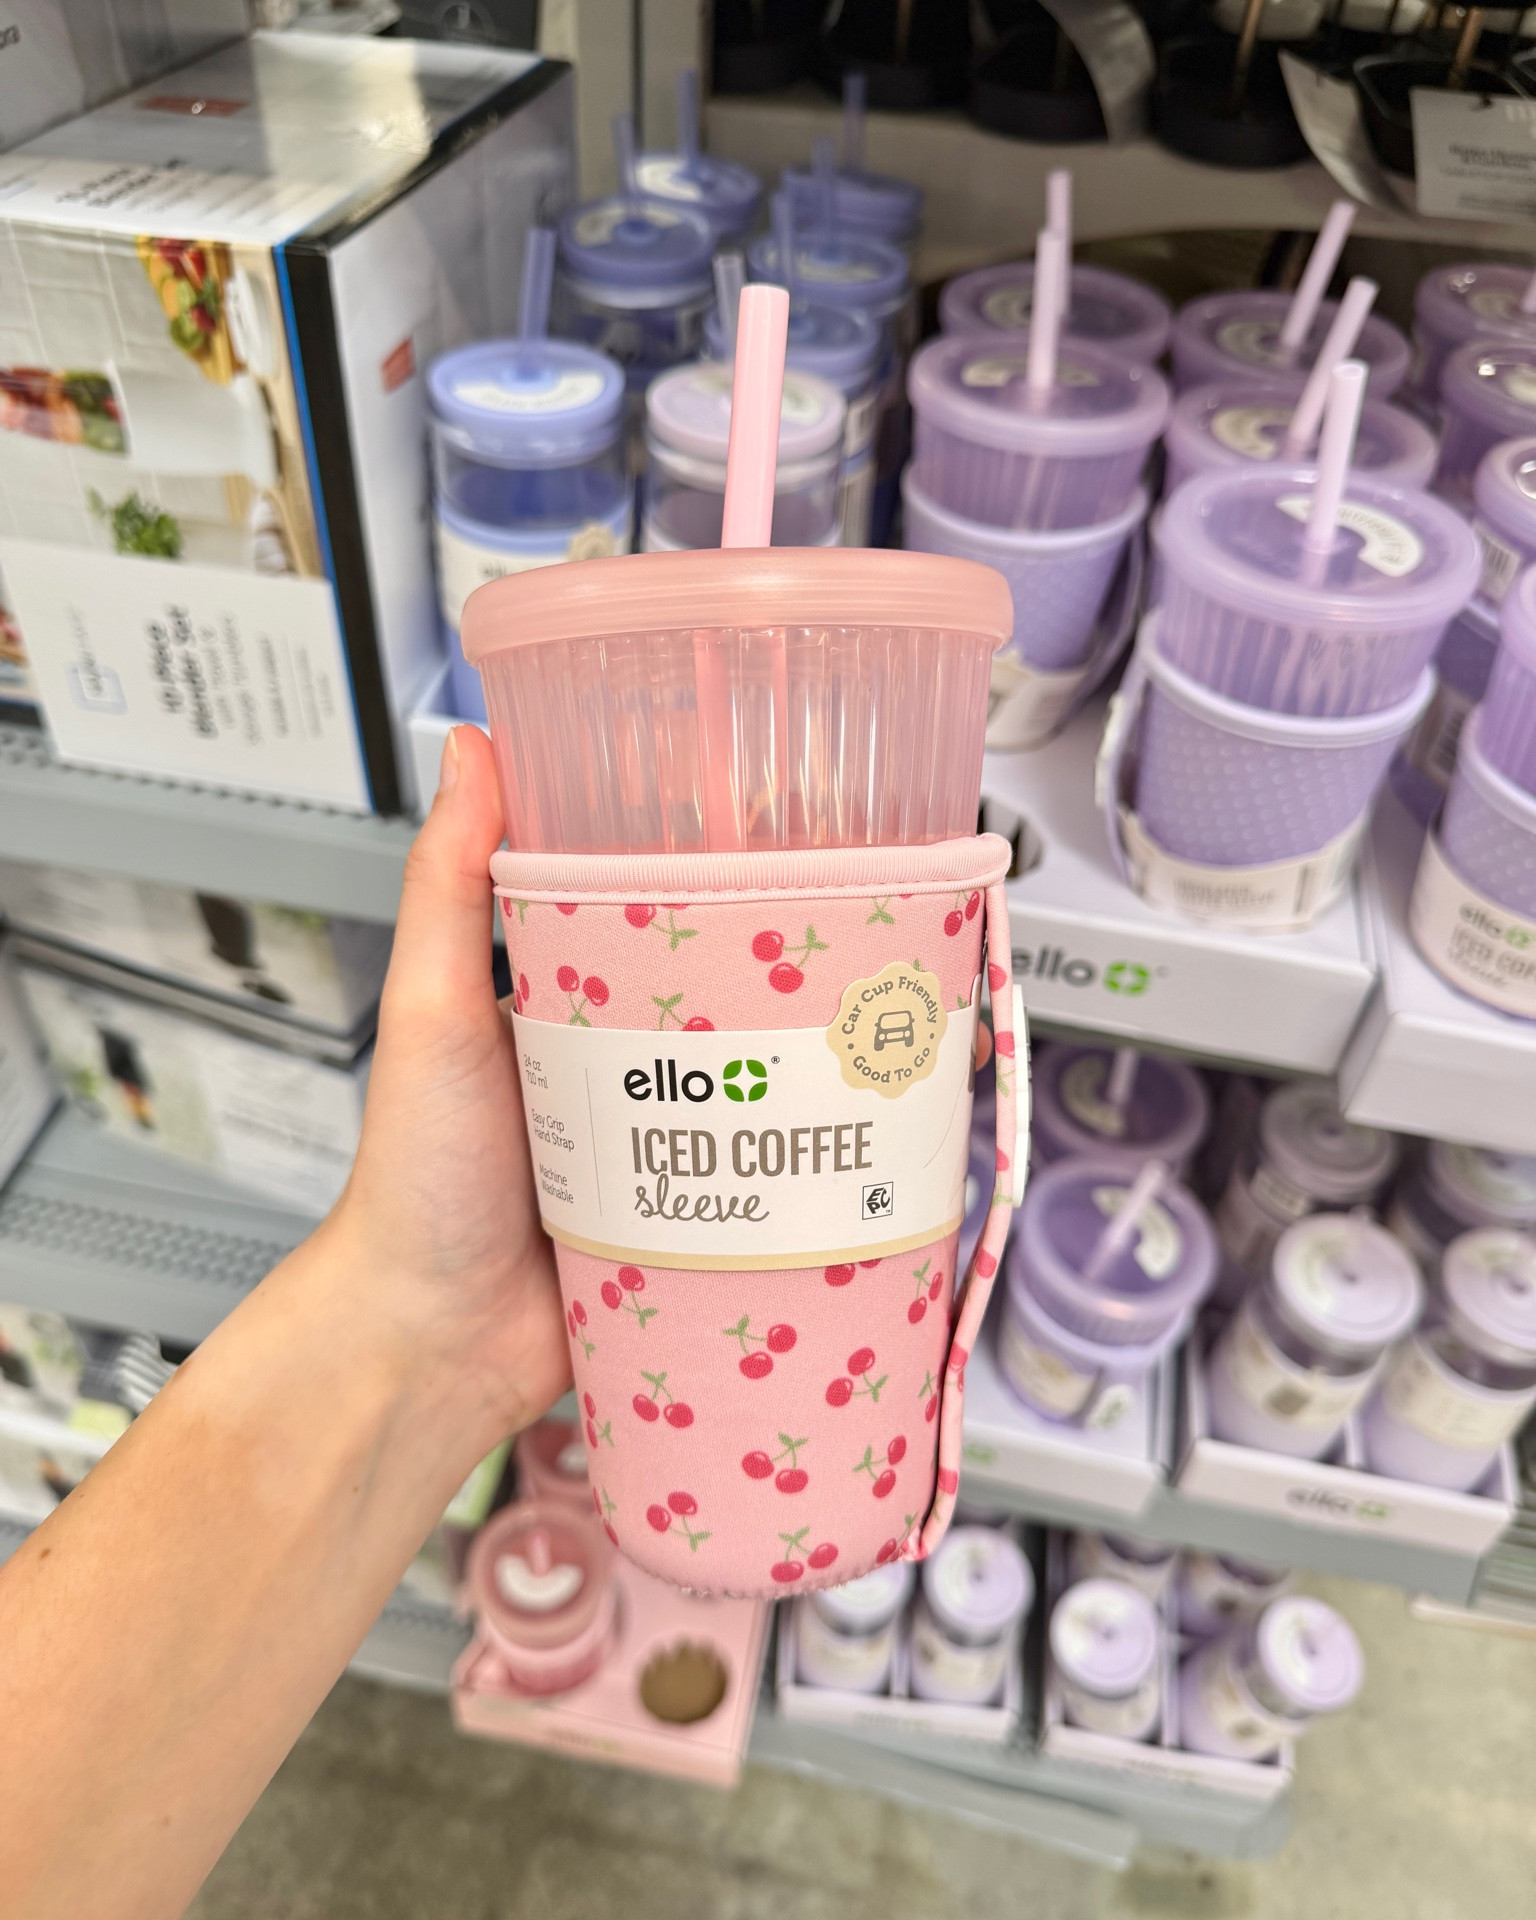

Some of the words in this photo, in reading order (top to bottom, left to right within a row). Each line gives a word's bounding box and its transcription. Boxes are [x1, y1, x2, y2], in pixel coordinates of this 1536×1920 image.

[1459, 902, 1502, 940] ello
[1011, 945, 1097, 987] ello
[842, 1004, 862, 1035] Car
[861, 980, 894, 1003] Cup
[898, 976, 938, 1024] Friendly
[523, 1054, 532, 1068] 24
[532, 1060, 542, 1072] oz
[624, 1059, 714, 1102] ello
[853, 1055, 891, 1083] Good
[894, 1067, 912, 1082] To
[914, 1047, 931, 1068] Go
[531, 1108, 545, 1128] Easy
[546, 1115, 565, 1133] Grip
[534, 1125, 551, 1144] Hand
[552, 1132, 575, 1152] Strap
[631, 1126, 717, 1177] ICED
[731, 1121, 873, 1178] COFFEE
[539, 1163, 568, 1186] Machine
[541, 1179, 574, 1204] Washable
[634, 1173, 770, 1223] sleeve
